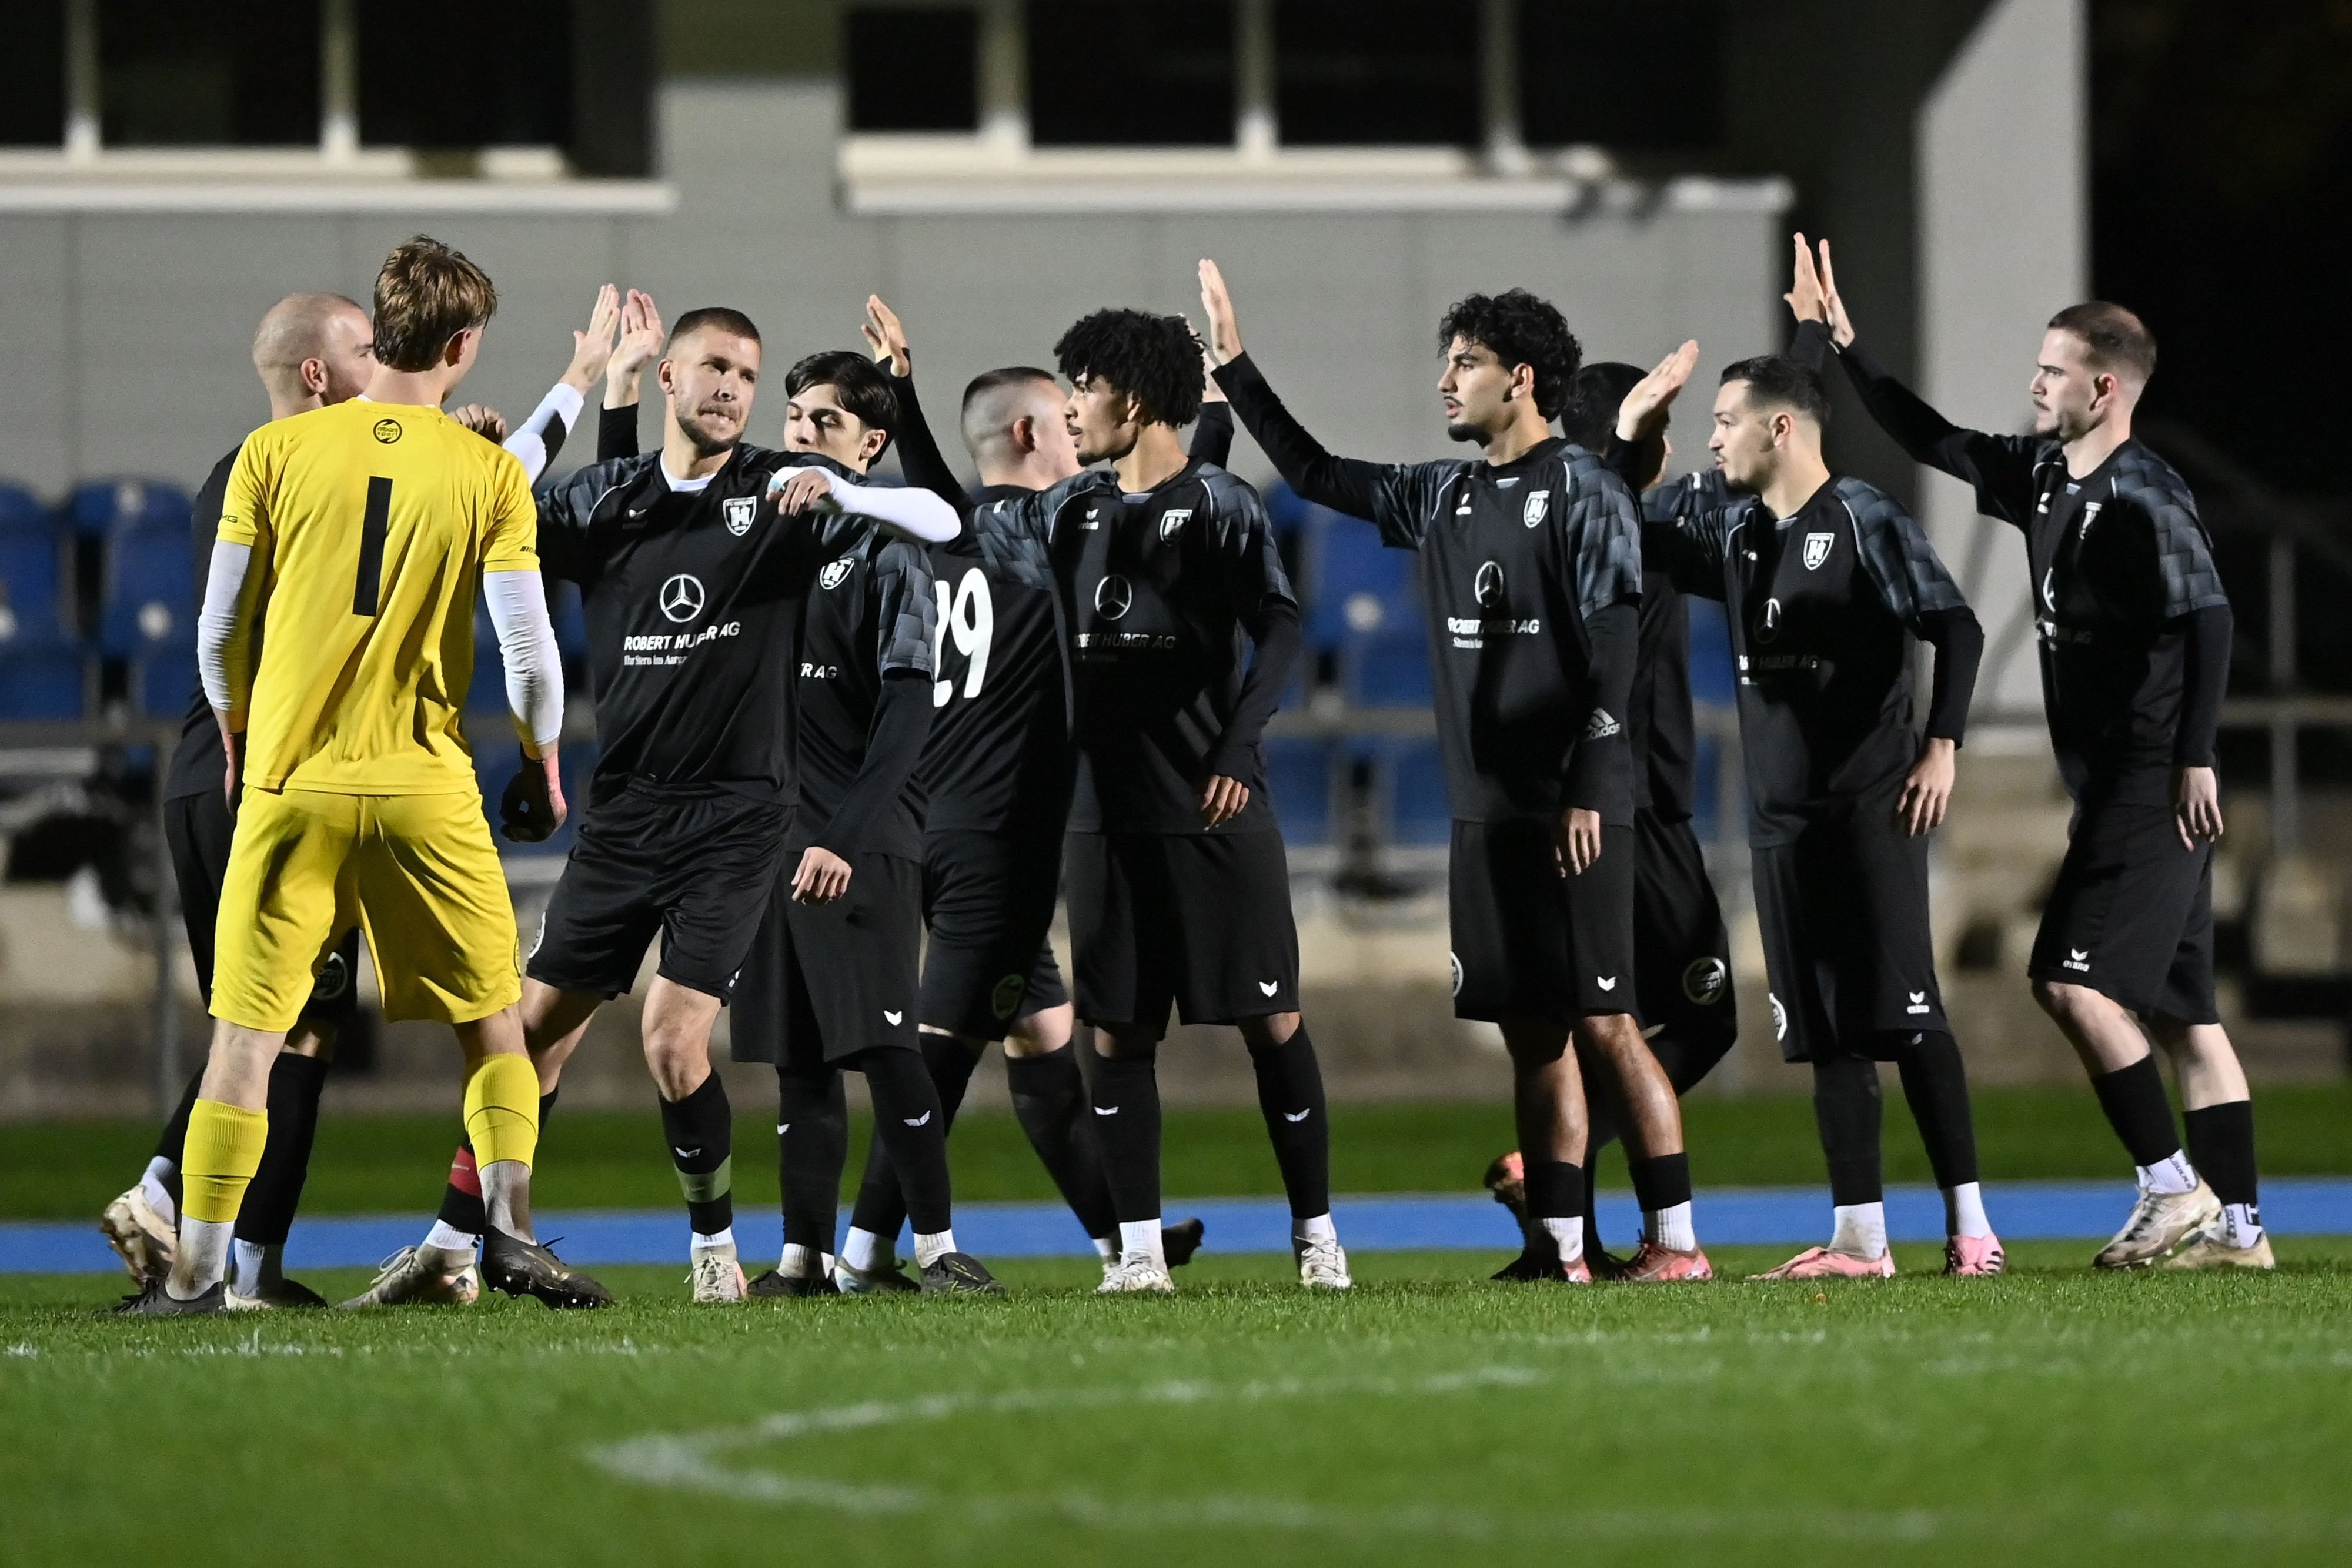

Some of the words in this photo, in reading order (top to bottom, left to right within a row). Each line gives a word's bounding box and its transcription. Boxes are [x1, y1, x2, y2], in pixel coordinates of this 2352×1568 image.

[352, 476, 393, 617] 1
[1517, 618, 1540, 634] AG
[623, 635, 673, 650] ROBERT
[718, 621, 741, 638] AG
[1152, 634, 1177, 649] AG
[814, 664, 838, 679] AG
[1586, 723, 1621, 740] didas
